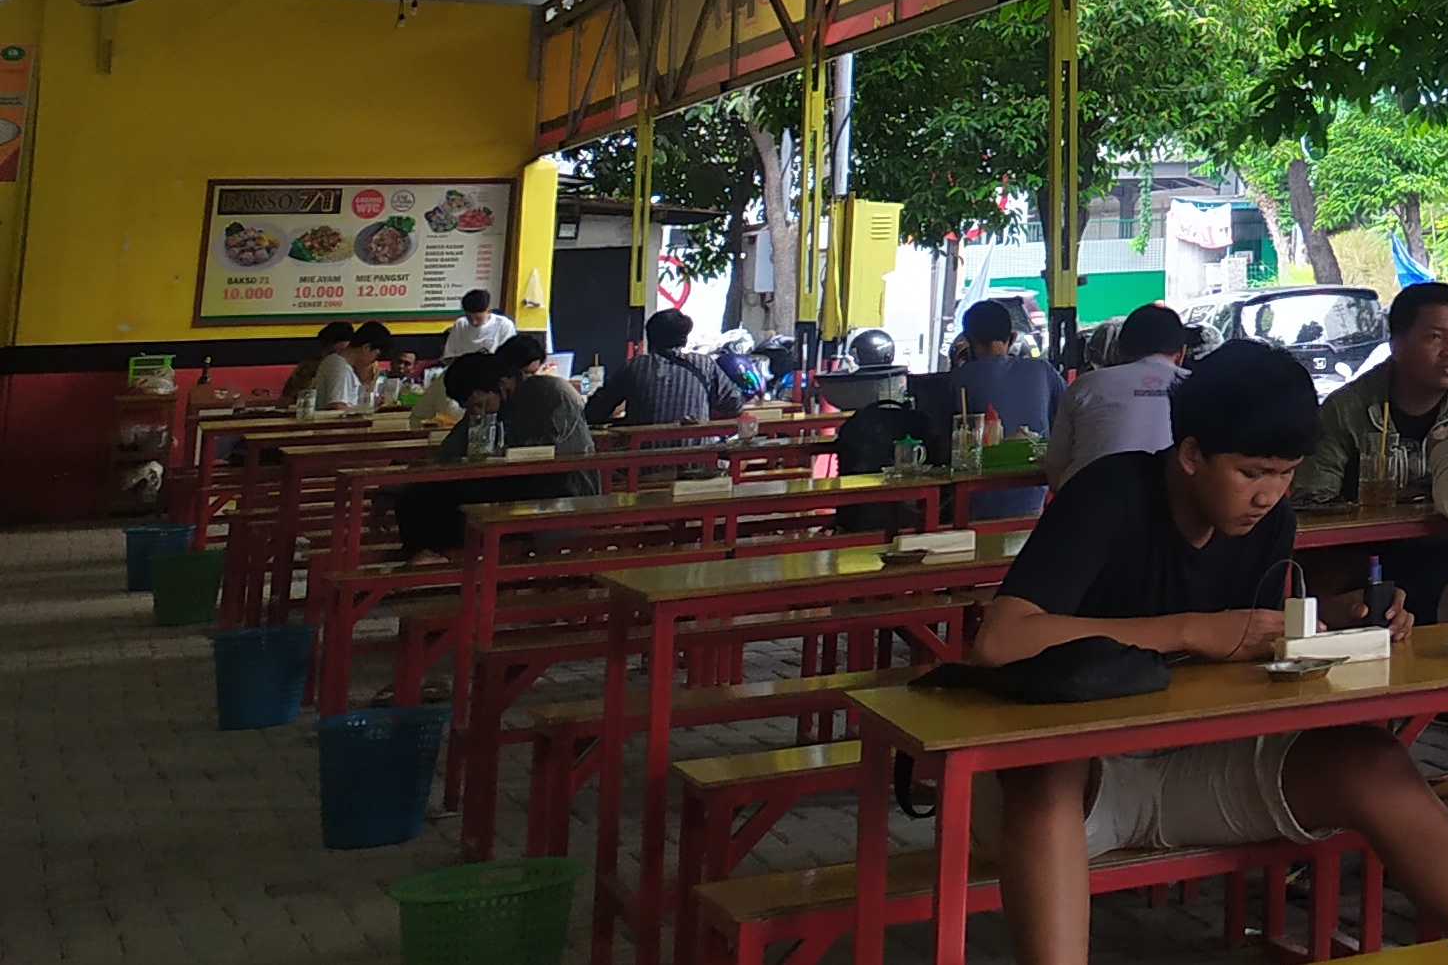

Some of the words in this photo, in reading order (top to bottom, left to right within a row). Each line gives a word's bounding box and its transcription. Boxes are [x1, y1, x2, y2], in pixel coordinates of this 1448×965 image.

[223, 193, 293, 210] BAKSO
[356, 203, 380, 213] WTC
[227, 277, 256, 285] BAKSO
[299, 276, 315, 284] MIE
[316, 275, 342, 283] AYAM
[355, 275, 372, 283] MIE
[373, 274, 410, 282] PANGSIT
[223, 287, 274, 300] 10.000
[294, 285, 345, 299] 10.000
[357, 284, 407, 297] 12.000
